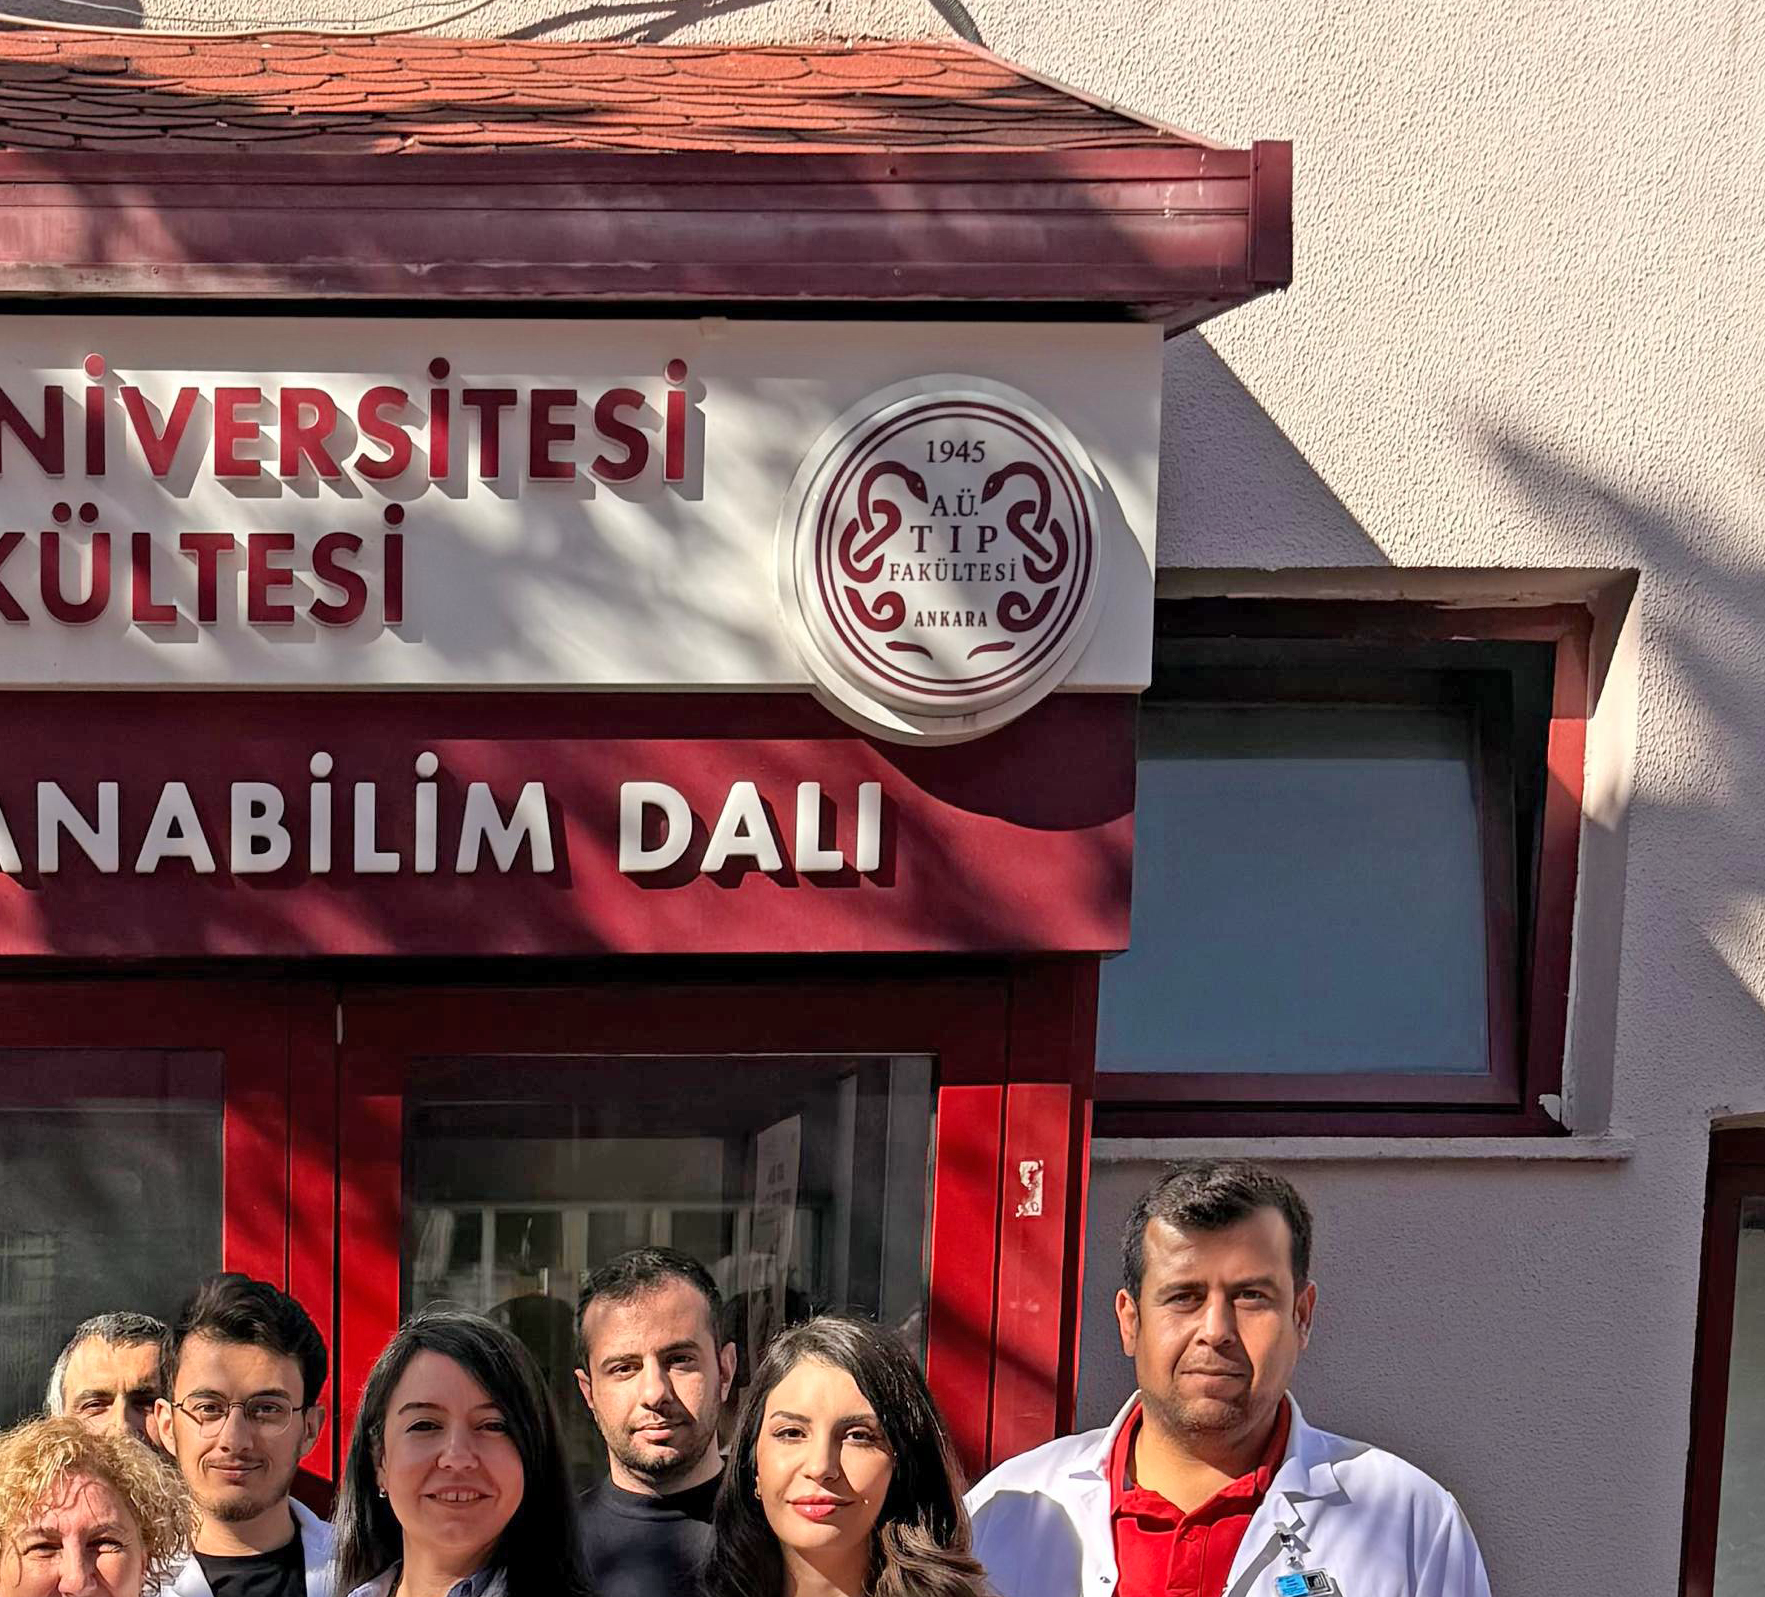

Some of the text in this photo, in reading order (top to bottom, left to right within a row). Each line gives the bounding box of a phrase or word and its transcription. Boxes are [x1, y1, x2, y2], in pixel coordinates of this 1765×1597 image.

[925, 439, 986, 464] 1945
[929, 488, 980, 518] A.Ü.
[909, 524, 999, 554] TIP
[888, 557, 1017, 582] FAKÜLTESİ
[913, 609, 989, 628] ANKARA
[616, 780, 884, 877] DALI
